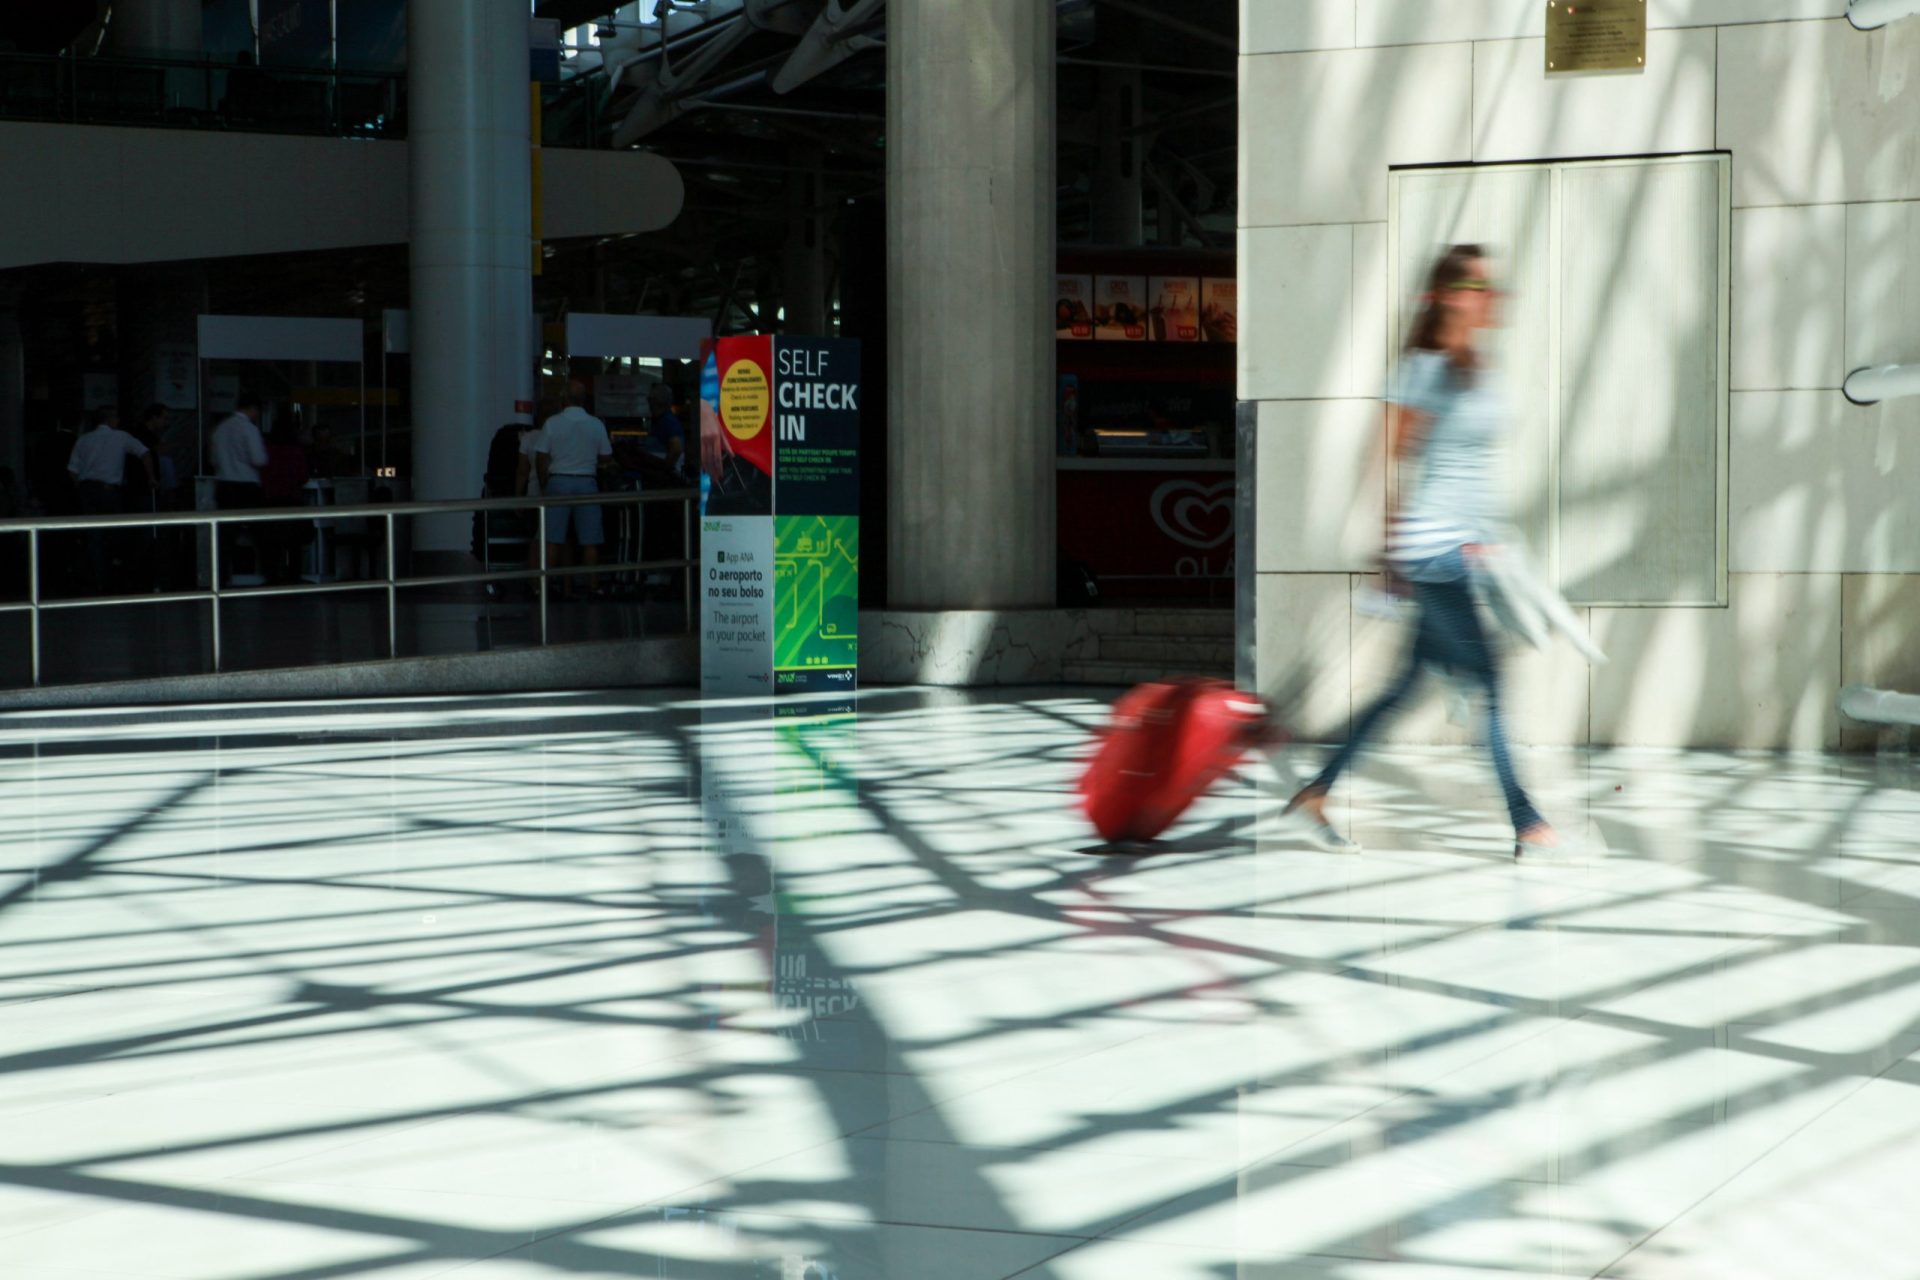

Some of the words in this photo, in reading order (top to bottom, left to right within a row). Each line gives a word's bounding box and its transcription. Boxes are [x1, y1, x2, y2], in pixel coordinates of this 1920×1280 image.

[778, 348, 830, 377] SELF
[778, 381, 858, 411] CHECK
[779, 414, 806, 441] IN
[726, 552, 739, 564] App
[709, 568, 717, 581] O
[718, 569, 763, 584] aeroporto
[708, 587, 720, 597] no
[721, 587, 738, 598] seu
[740, 585, 764, 598] bolso
[713, 610, 730, 625] The
[731, 611, 759, 627] airport
[706, 629, 715, 641] in
[715, 630, 735, 644] your
[737, 629, 766, 645] pocket
